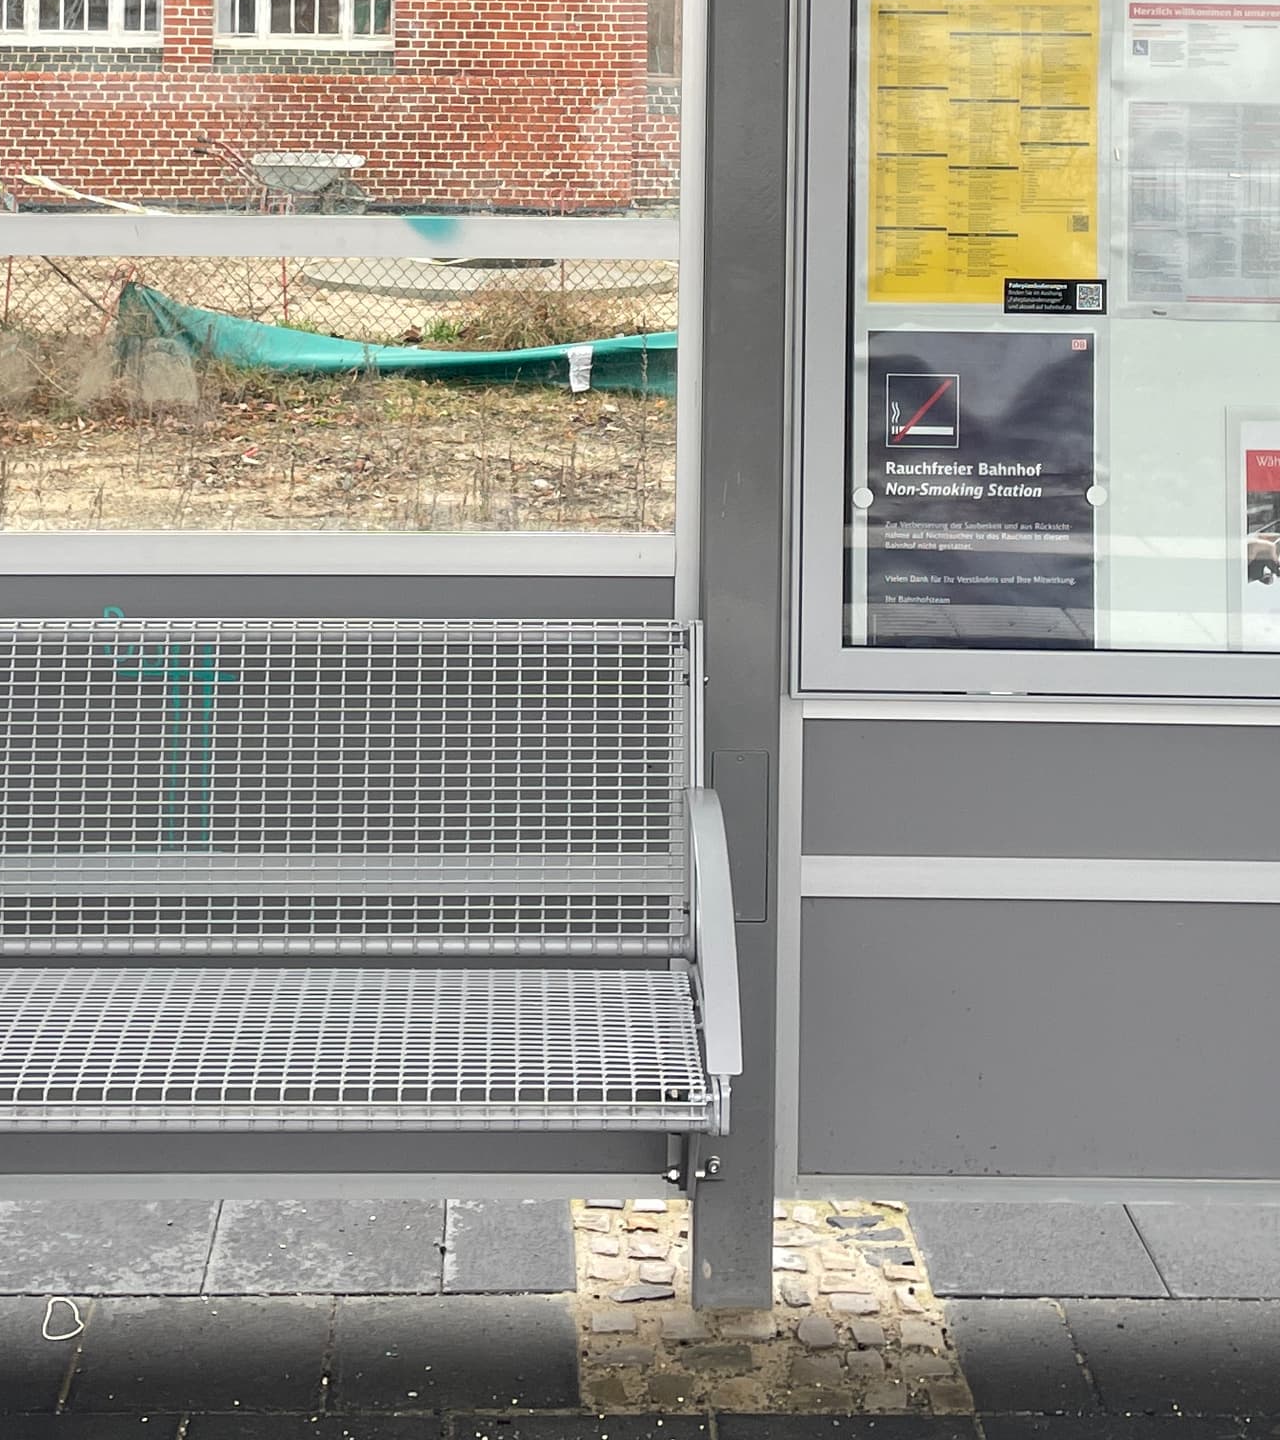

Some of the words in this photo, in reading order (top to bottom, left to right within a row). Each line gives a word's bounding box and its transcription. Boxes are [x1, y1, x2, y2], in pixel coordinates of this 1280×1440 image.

[1133, 7, 1173, 16] Herzlich
[1174, 7, 1231, 17] willkommen
[1233, 7, 1243, 17] in
[886, 462, 973, 475] Rauchfreier
[978, 462, 1042, 477] Bahnhof
[885, 482, 984, 500] Non-Smoking
[987, 483, 1042, 498] Station
[1004, 522, 1018, 530] und
[885, 542, 916, 550] Bahnhof
[885, 575, 908, 583] Vielen
[910, 575, 929, 583] Dank
[931, 575, 942, 584] für
[1001, 576, 1015, 584] und
[885, 596, 897, 604] Ihr
